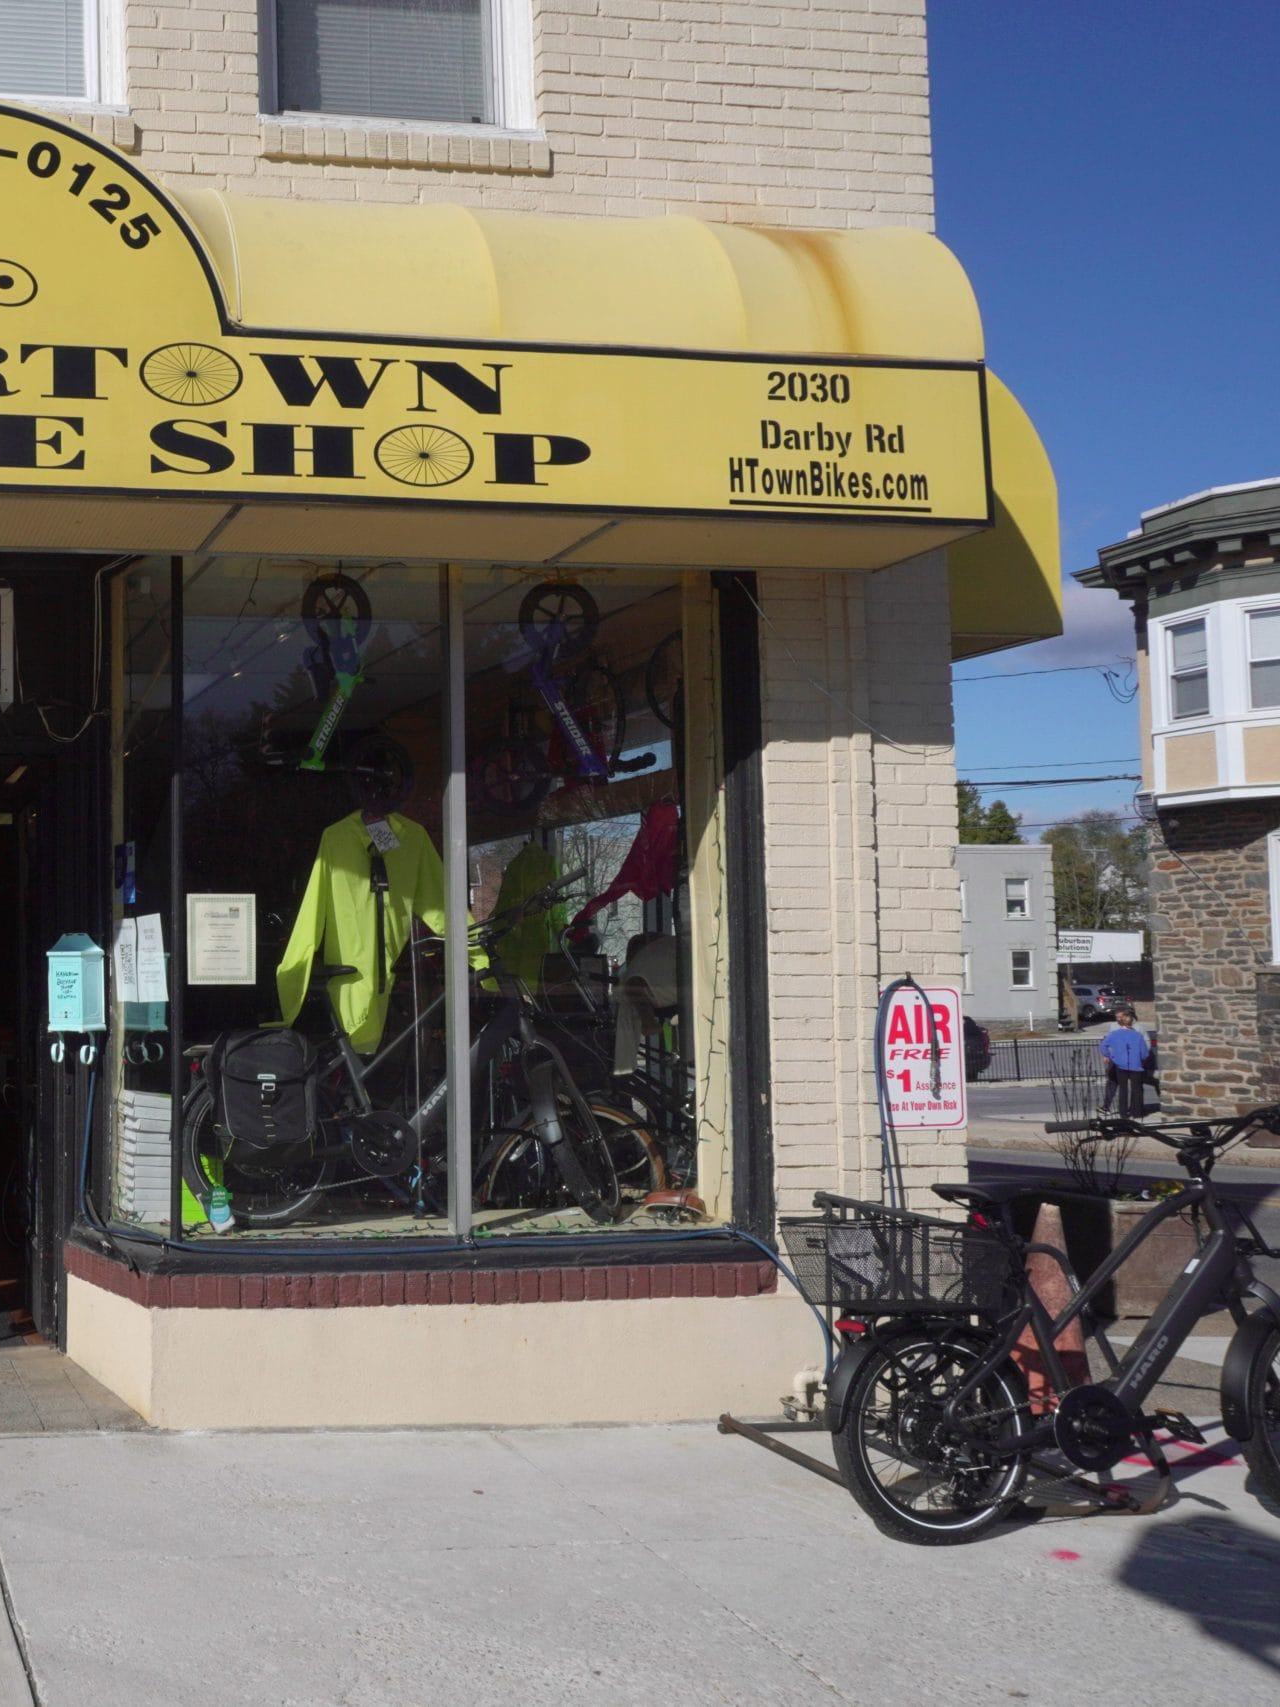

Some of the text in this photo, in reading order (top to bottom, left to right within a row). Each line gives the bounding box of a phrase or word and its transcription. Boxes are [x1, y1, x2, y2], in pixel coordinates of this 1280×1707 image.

[767, 371, 851, 404] 2030
[148, 419, 592, 488] SHOP
[760, 420, 906, 457] Darby Rd
[729, 456, 929, 502] HTownBikes.com
[315, 695, 344, 751] STRIDER
[554, 701, 591, 756] STRIDER
[887, 1004, 951, 1044] AIR
[889, 1047, 951, 1060] FREE
[886, 1069, 911, 1092] $1
[421, 1084, 448, 1116] HAR
[901, 1101, 909, 1111] At
[910, 1101, 926, 1111] Your
[927, 1100, 941, 1110] Own
[943, 1100, 958, 1110] Risk
[1129, 1334, 1169, 1389] HARO
